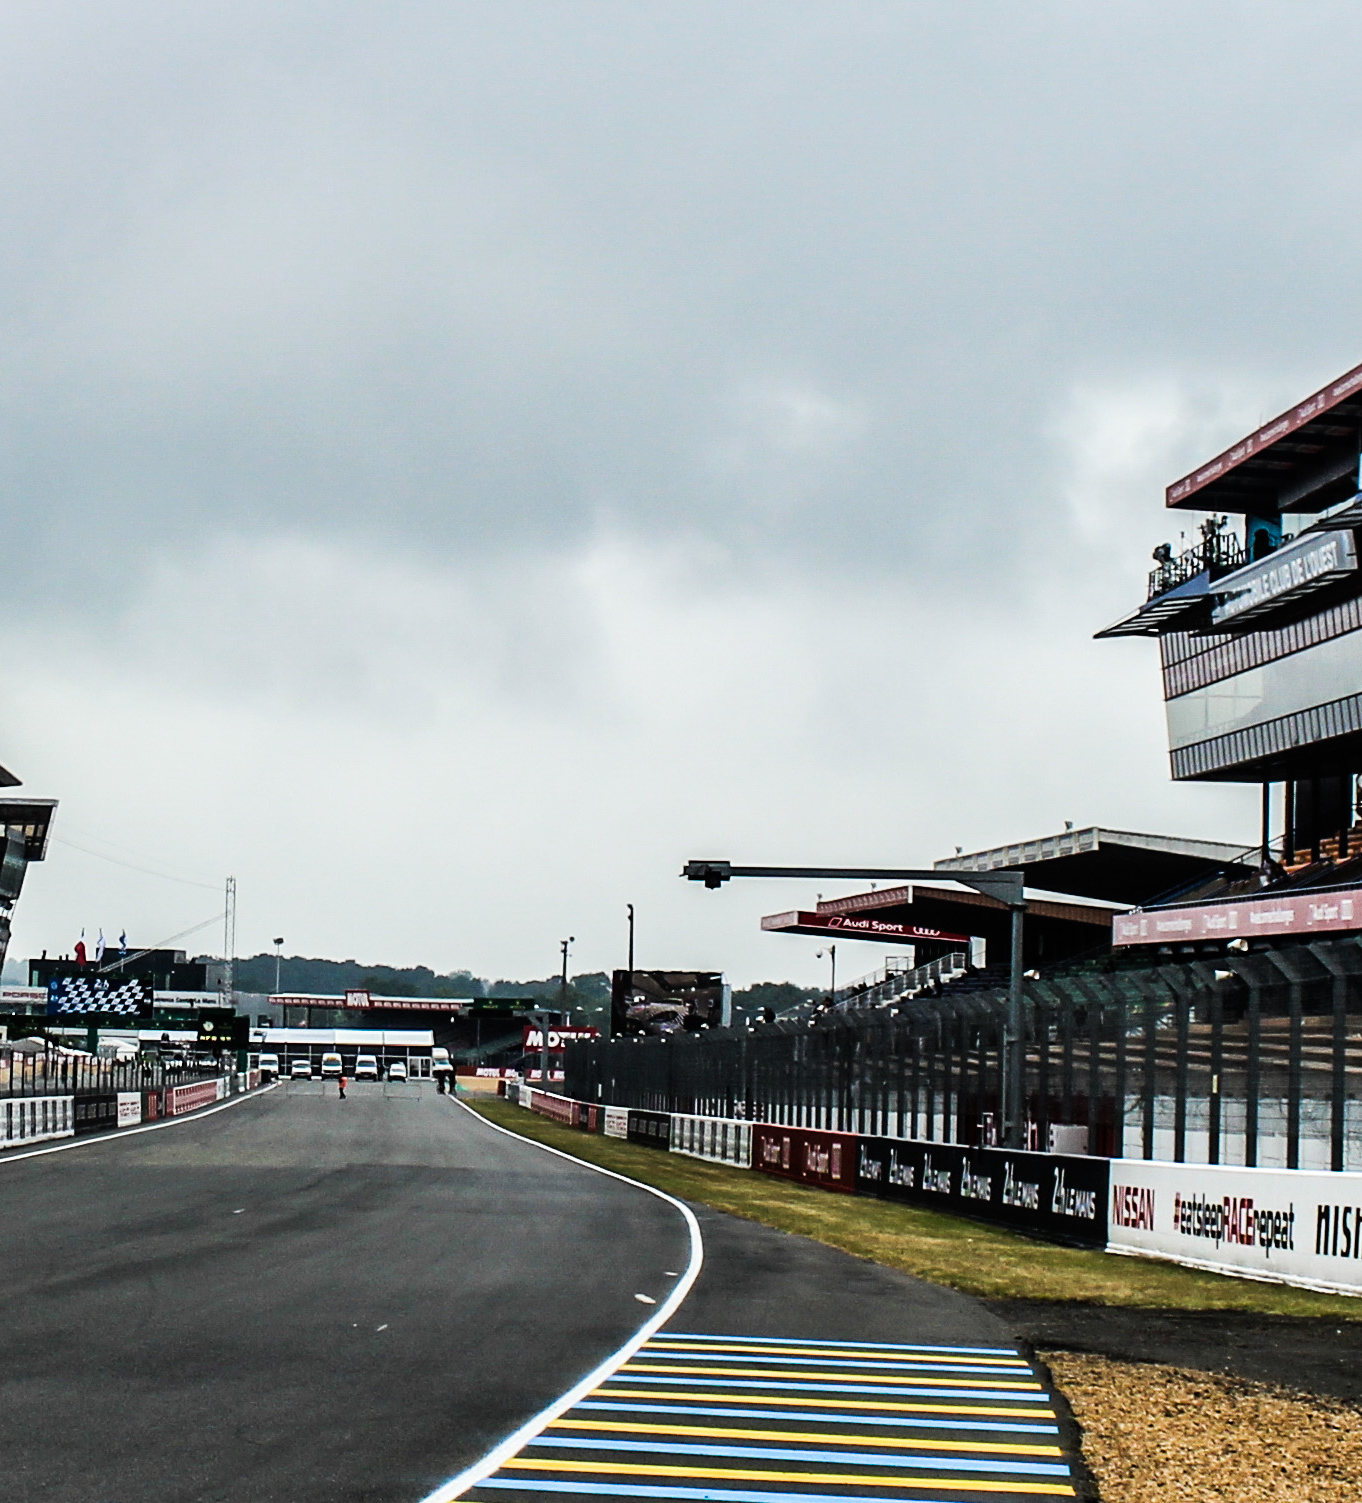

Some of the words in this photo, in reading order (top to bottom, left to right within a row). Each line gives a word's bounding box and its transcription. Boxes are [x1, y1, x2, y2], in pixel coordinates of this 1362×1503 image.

[843, 918, 870, 928] Audi
[872, 920, 904, 933] Sport
[1113, 1185, 1155, 1231] NISSAN
[1174, 1192, 1294, 1259] #eatsleepRACErepeat
